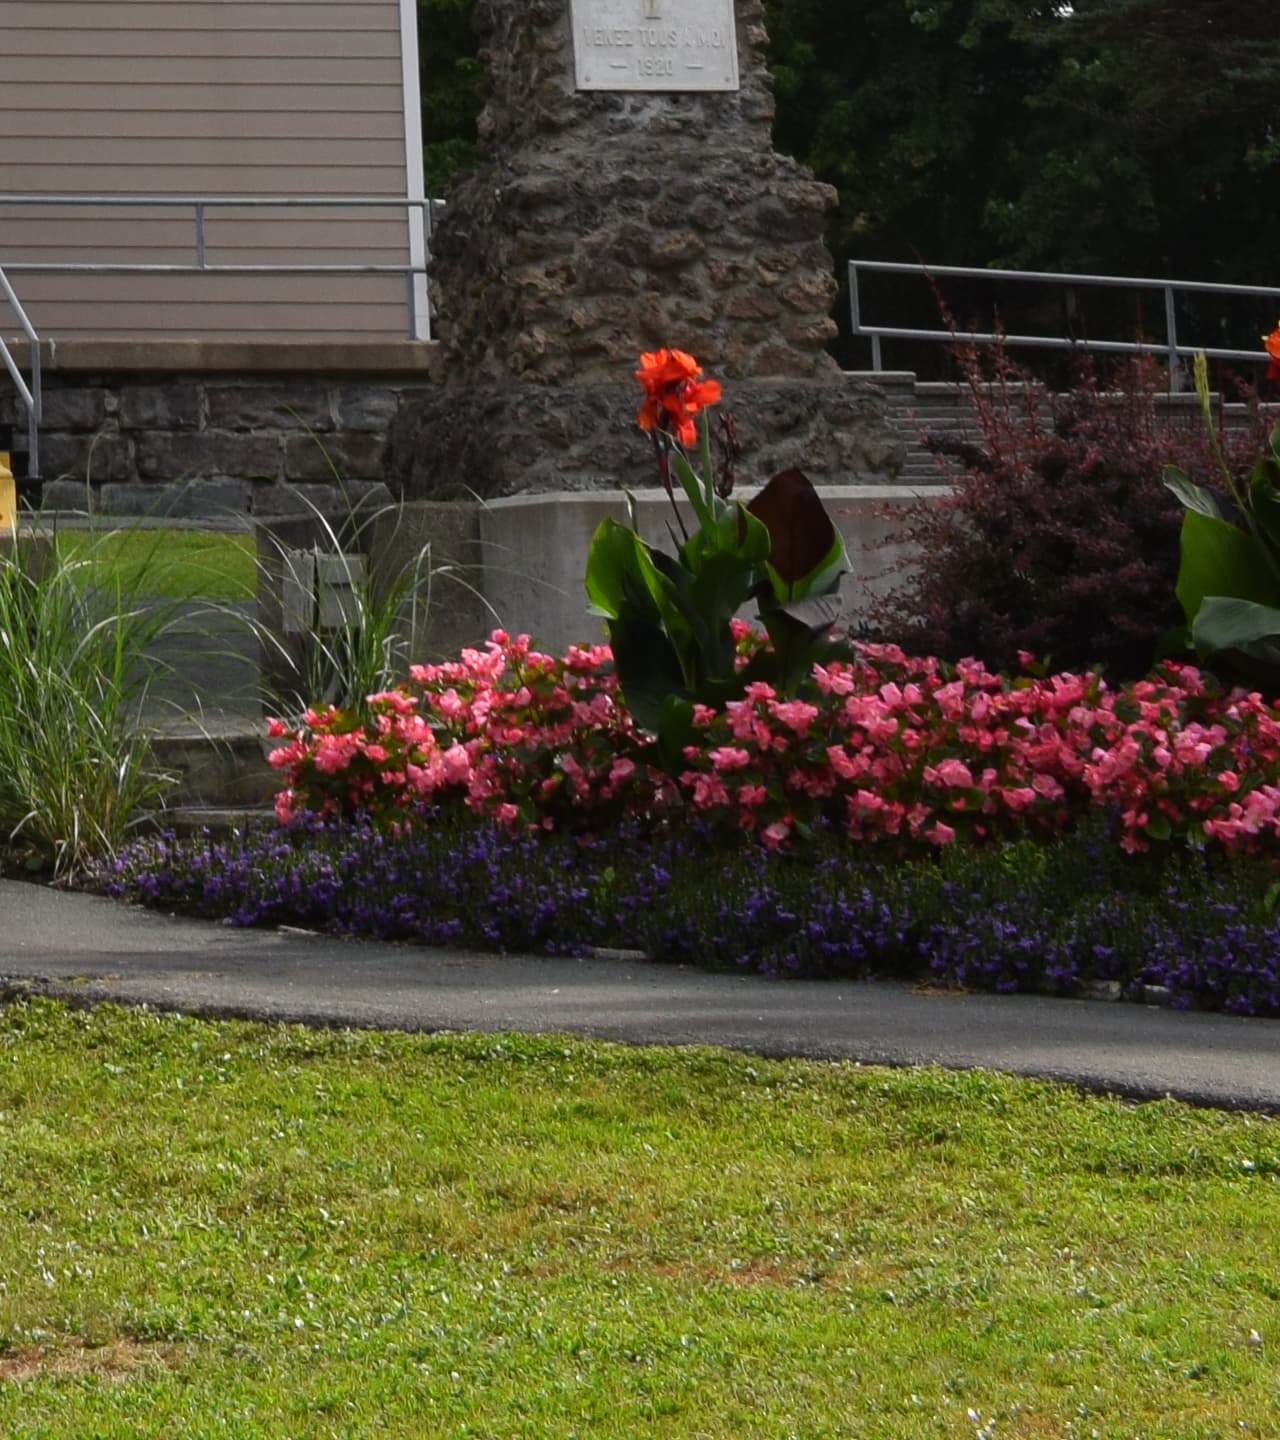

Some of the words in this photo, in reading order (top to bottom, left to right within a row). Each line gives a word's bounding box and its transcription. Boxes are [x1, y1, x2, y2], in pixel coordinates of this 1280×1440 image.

[583, 26, 633, 47] VENEZ
[638, 26, 678, 48] TOUS
[636, 57, 672, 77] 1920
